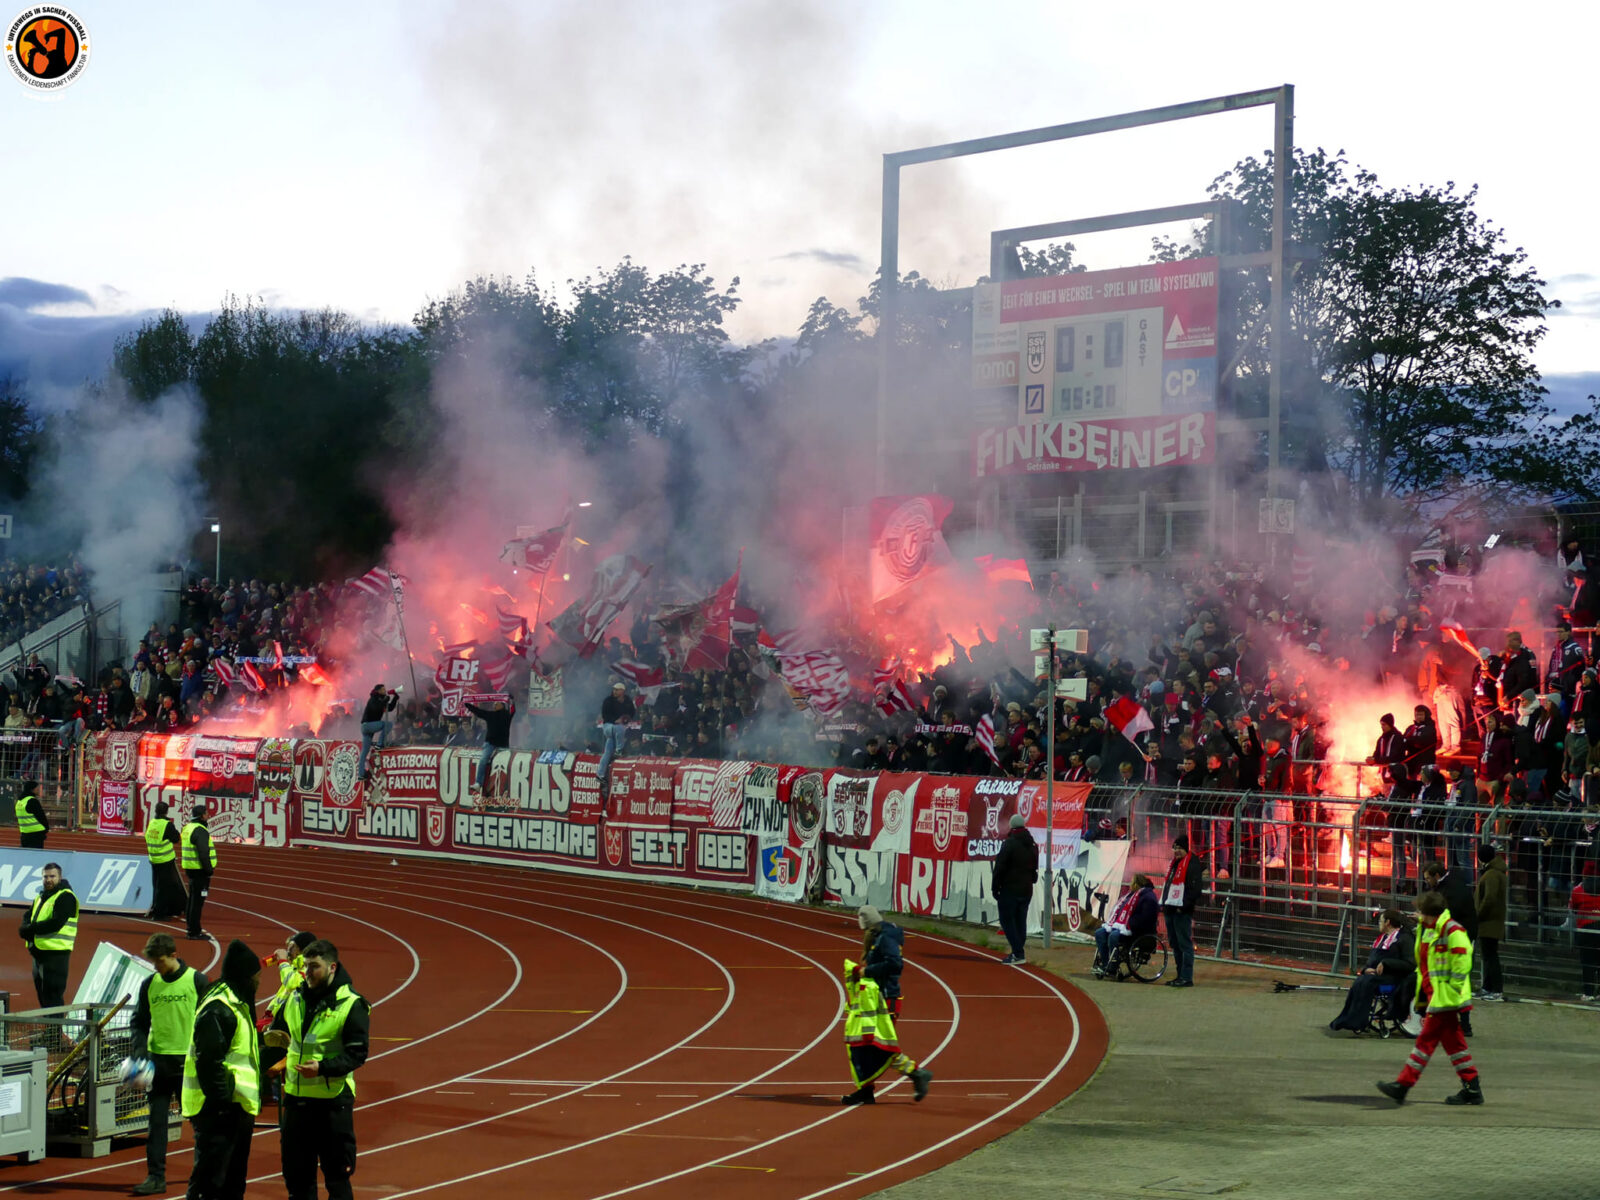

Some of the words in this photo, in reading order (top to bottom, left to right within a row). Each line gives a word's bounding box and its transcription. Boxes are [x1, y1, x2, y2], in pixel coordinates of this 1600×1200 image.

[1002, 294, 1018, 310] ZEIT
[1019, 289, 1034, 308] FÜR
[1035, 289, 1057, 306] EINEN
[1058, 285, 1094, 303] WECHSEL
[1103, 282, 1126, 298] SPIEL
[1127, 280, 1138, 296] IM
[1139, 278, 1162, 294] TEAM
[1163, 271, 1215, 292] SYSTEMZWO
[1028, 337, 1045, 347] SSV
[977, 412, 1206, 477] FINKBEINER
[1026, 461, 1060, 471] Getränke
[382, 754, 438, 768] RATISBONA
[574, 761, 599, 774] SEKTIO
[388, 775, 437, 790] FANATICA
[630, 799, 646, 815] vom
[1036, 796, 1082, 817] Jafreunde
[303, 800, 348, 832] SSV
[357, 804, 416, 839] JAHN
[454, 813, 597, 857] REGENSBURG
[631, 830, 687, 865] SEIT
